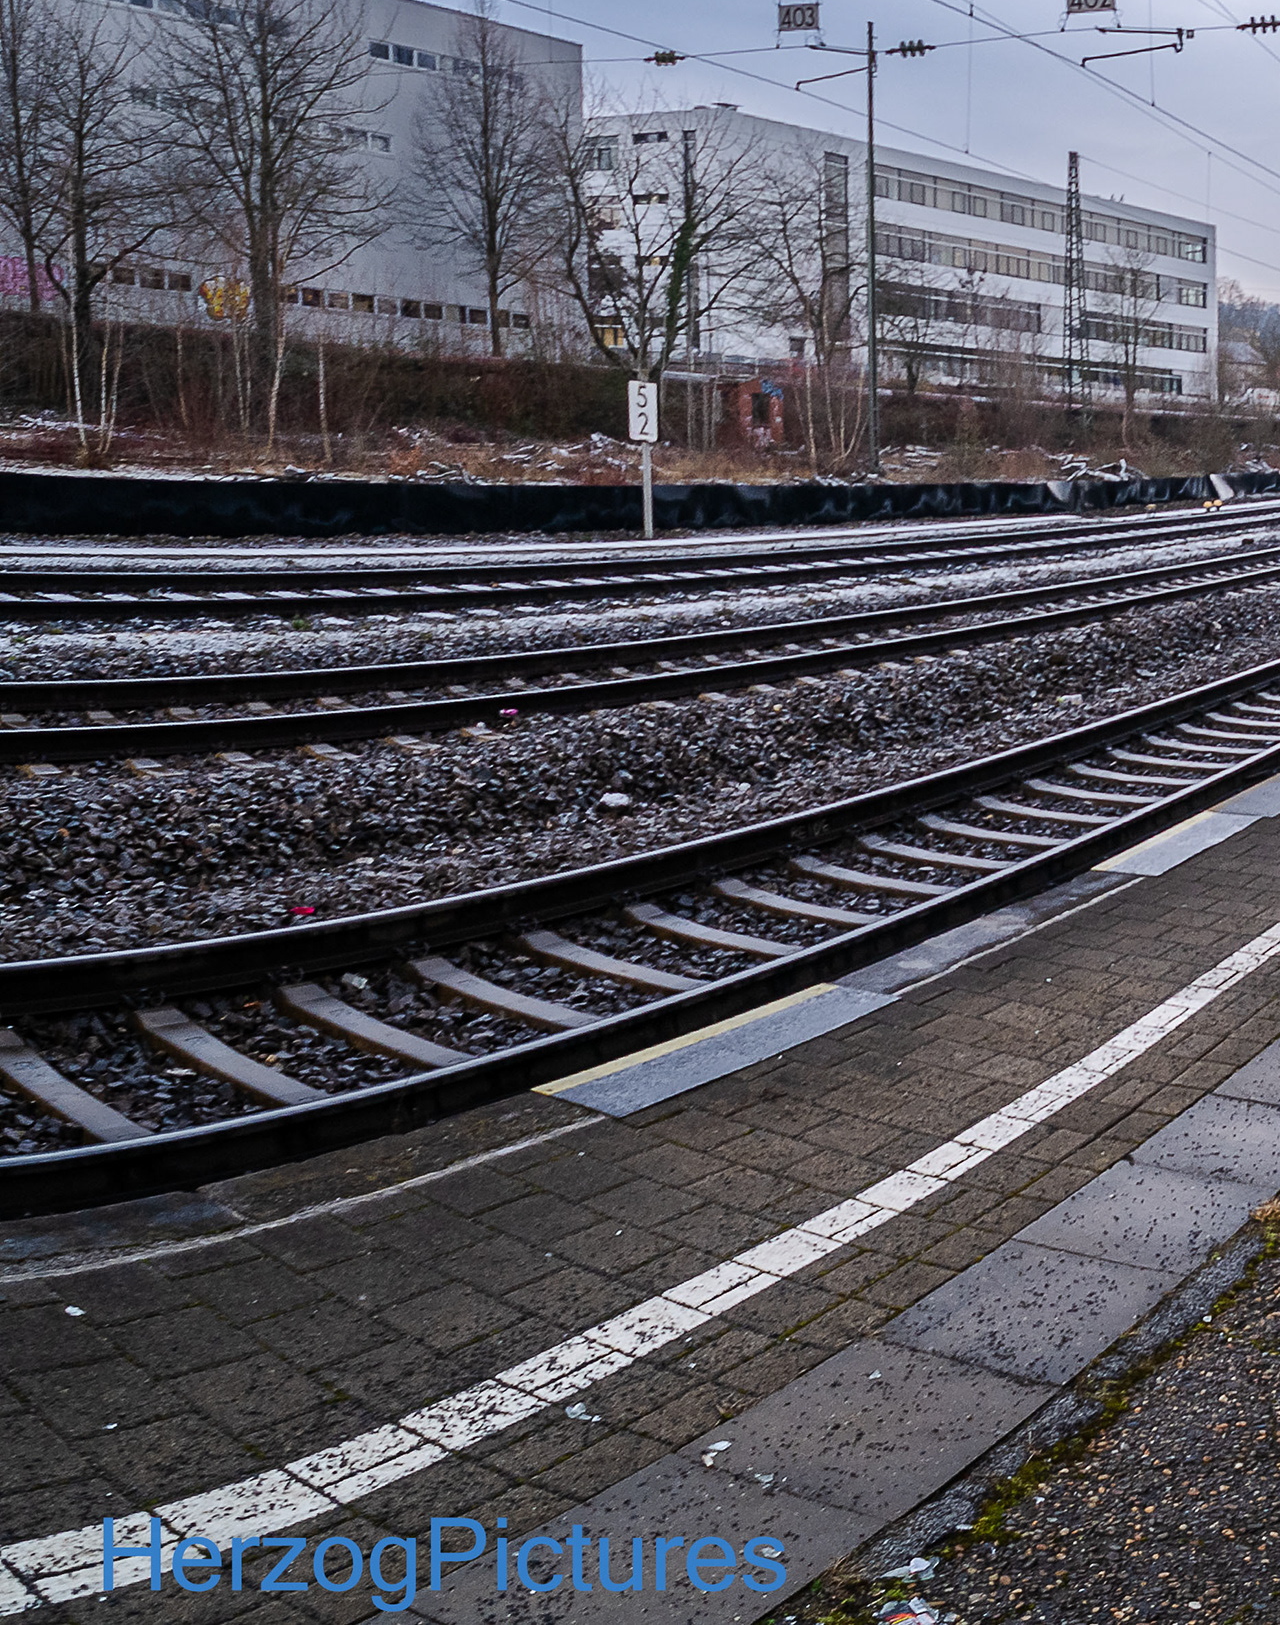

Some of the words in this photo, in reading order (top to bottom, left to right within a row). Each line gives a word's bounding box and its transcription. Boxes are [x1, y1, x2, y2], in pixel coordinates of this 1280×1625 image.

[781, 6, 816, 28] 403
[636, 385, 648, 408] 5
[637, 412, 649, 436] 2
